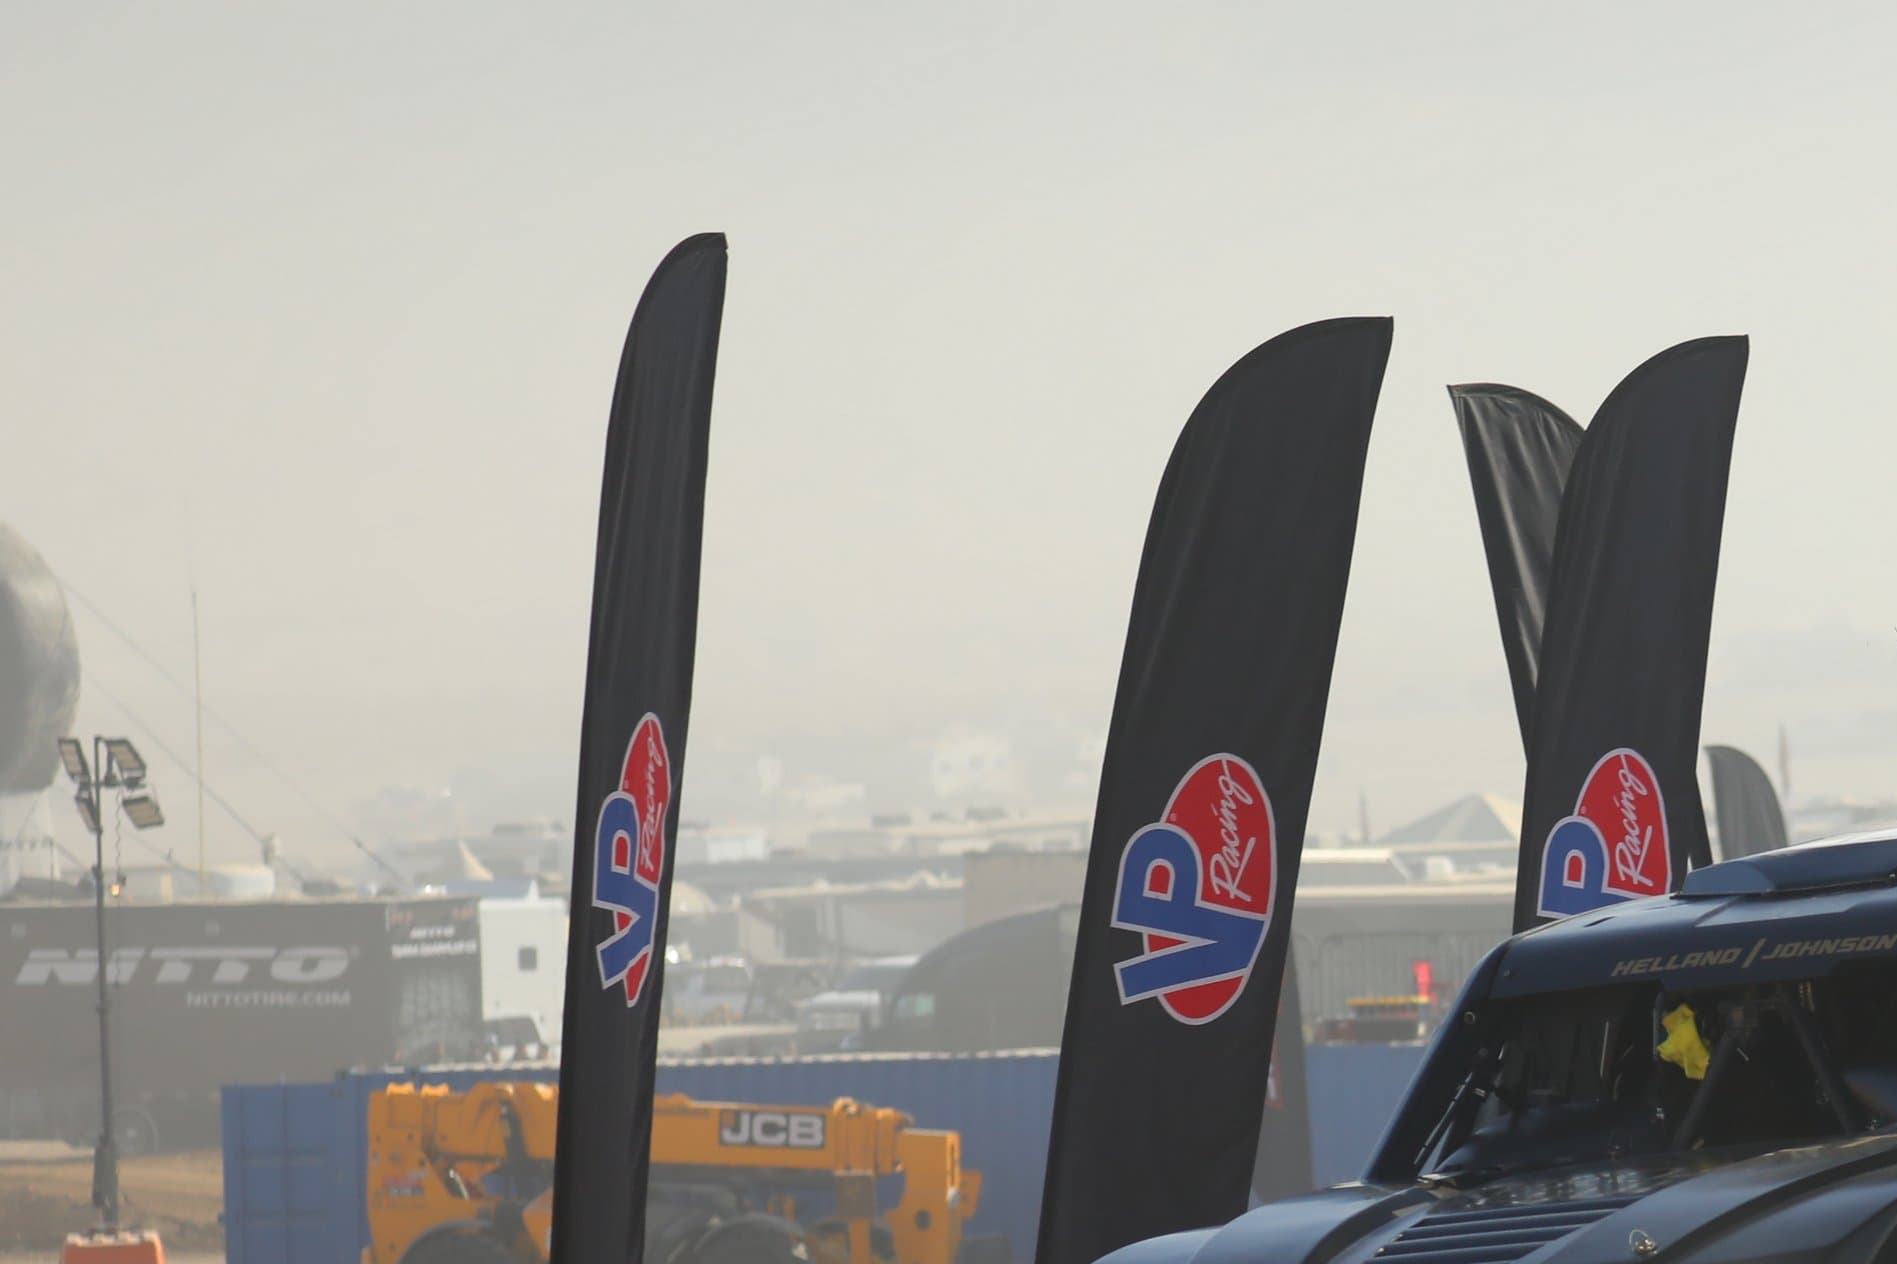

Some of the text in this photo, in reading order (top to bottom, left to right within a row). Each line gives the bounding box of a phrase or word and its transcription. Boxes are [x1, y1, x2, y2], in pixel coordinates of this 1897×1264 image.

[1209, 759, 1256, 902] Racing
[1616, 755, 1653, 887] Racing
[592, 790, 660, 990] VP
[1111, 821, 1271, 1006] VP
[15, 947, 350, 985] NITTO
[1610, 946, 1743, 977] HELLAND
[722, 1111, 824, 1146] JCB
